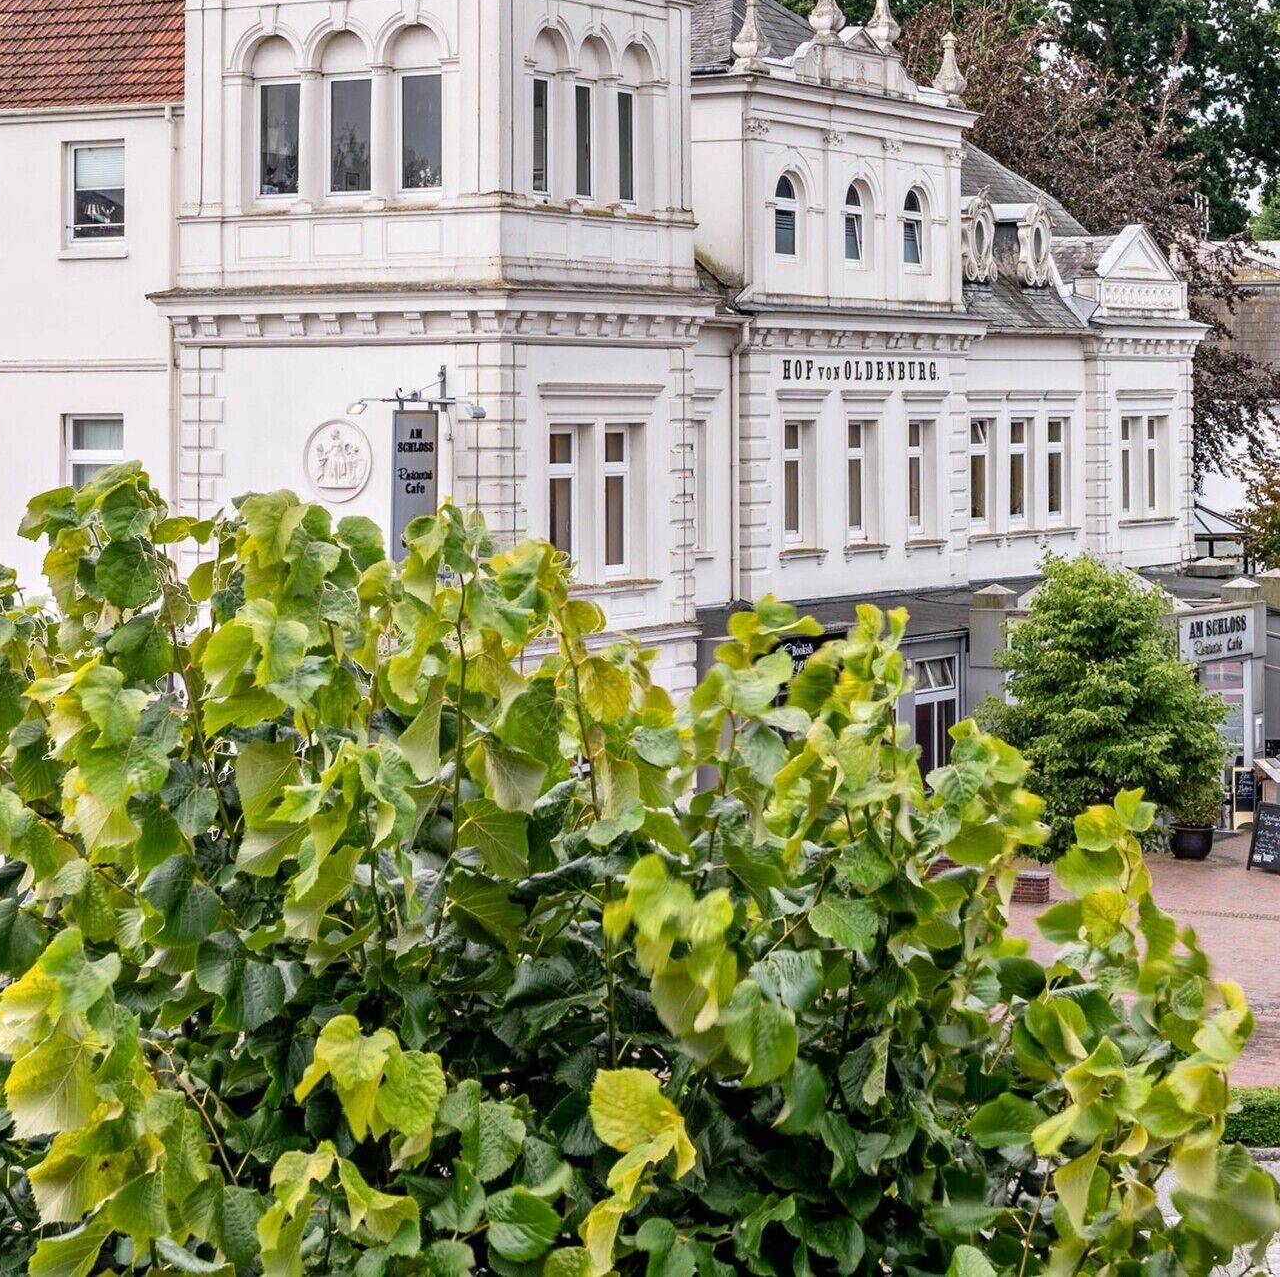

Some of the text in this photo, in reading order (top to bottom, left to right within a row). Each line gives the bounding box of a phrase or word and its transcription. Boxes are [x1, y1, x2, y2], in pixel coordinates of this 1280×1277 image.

[783, 360, 813, 380] HOF
[844, 361, 940, 381] OLDENBURG.
[409, 428, 423, 439] AM
[397, 442, 434, 453] SCHLOSS
[1189, 615, 1247, 639] AM SCHLOSS
[792, 643, 814, 657] Bookish
